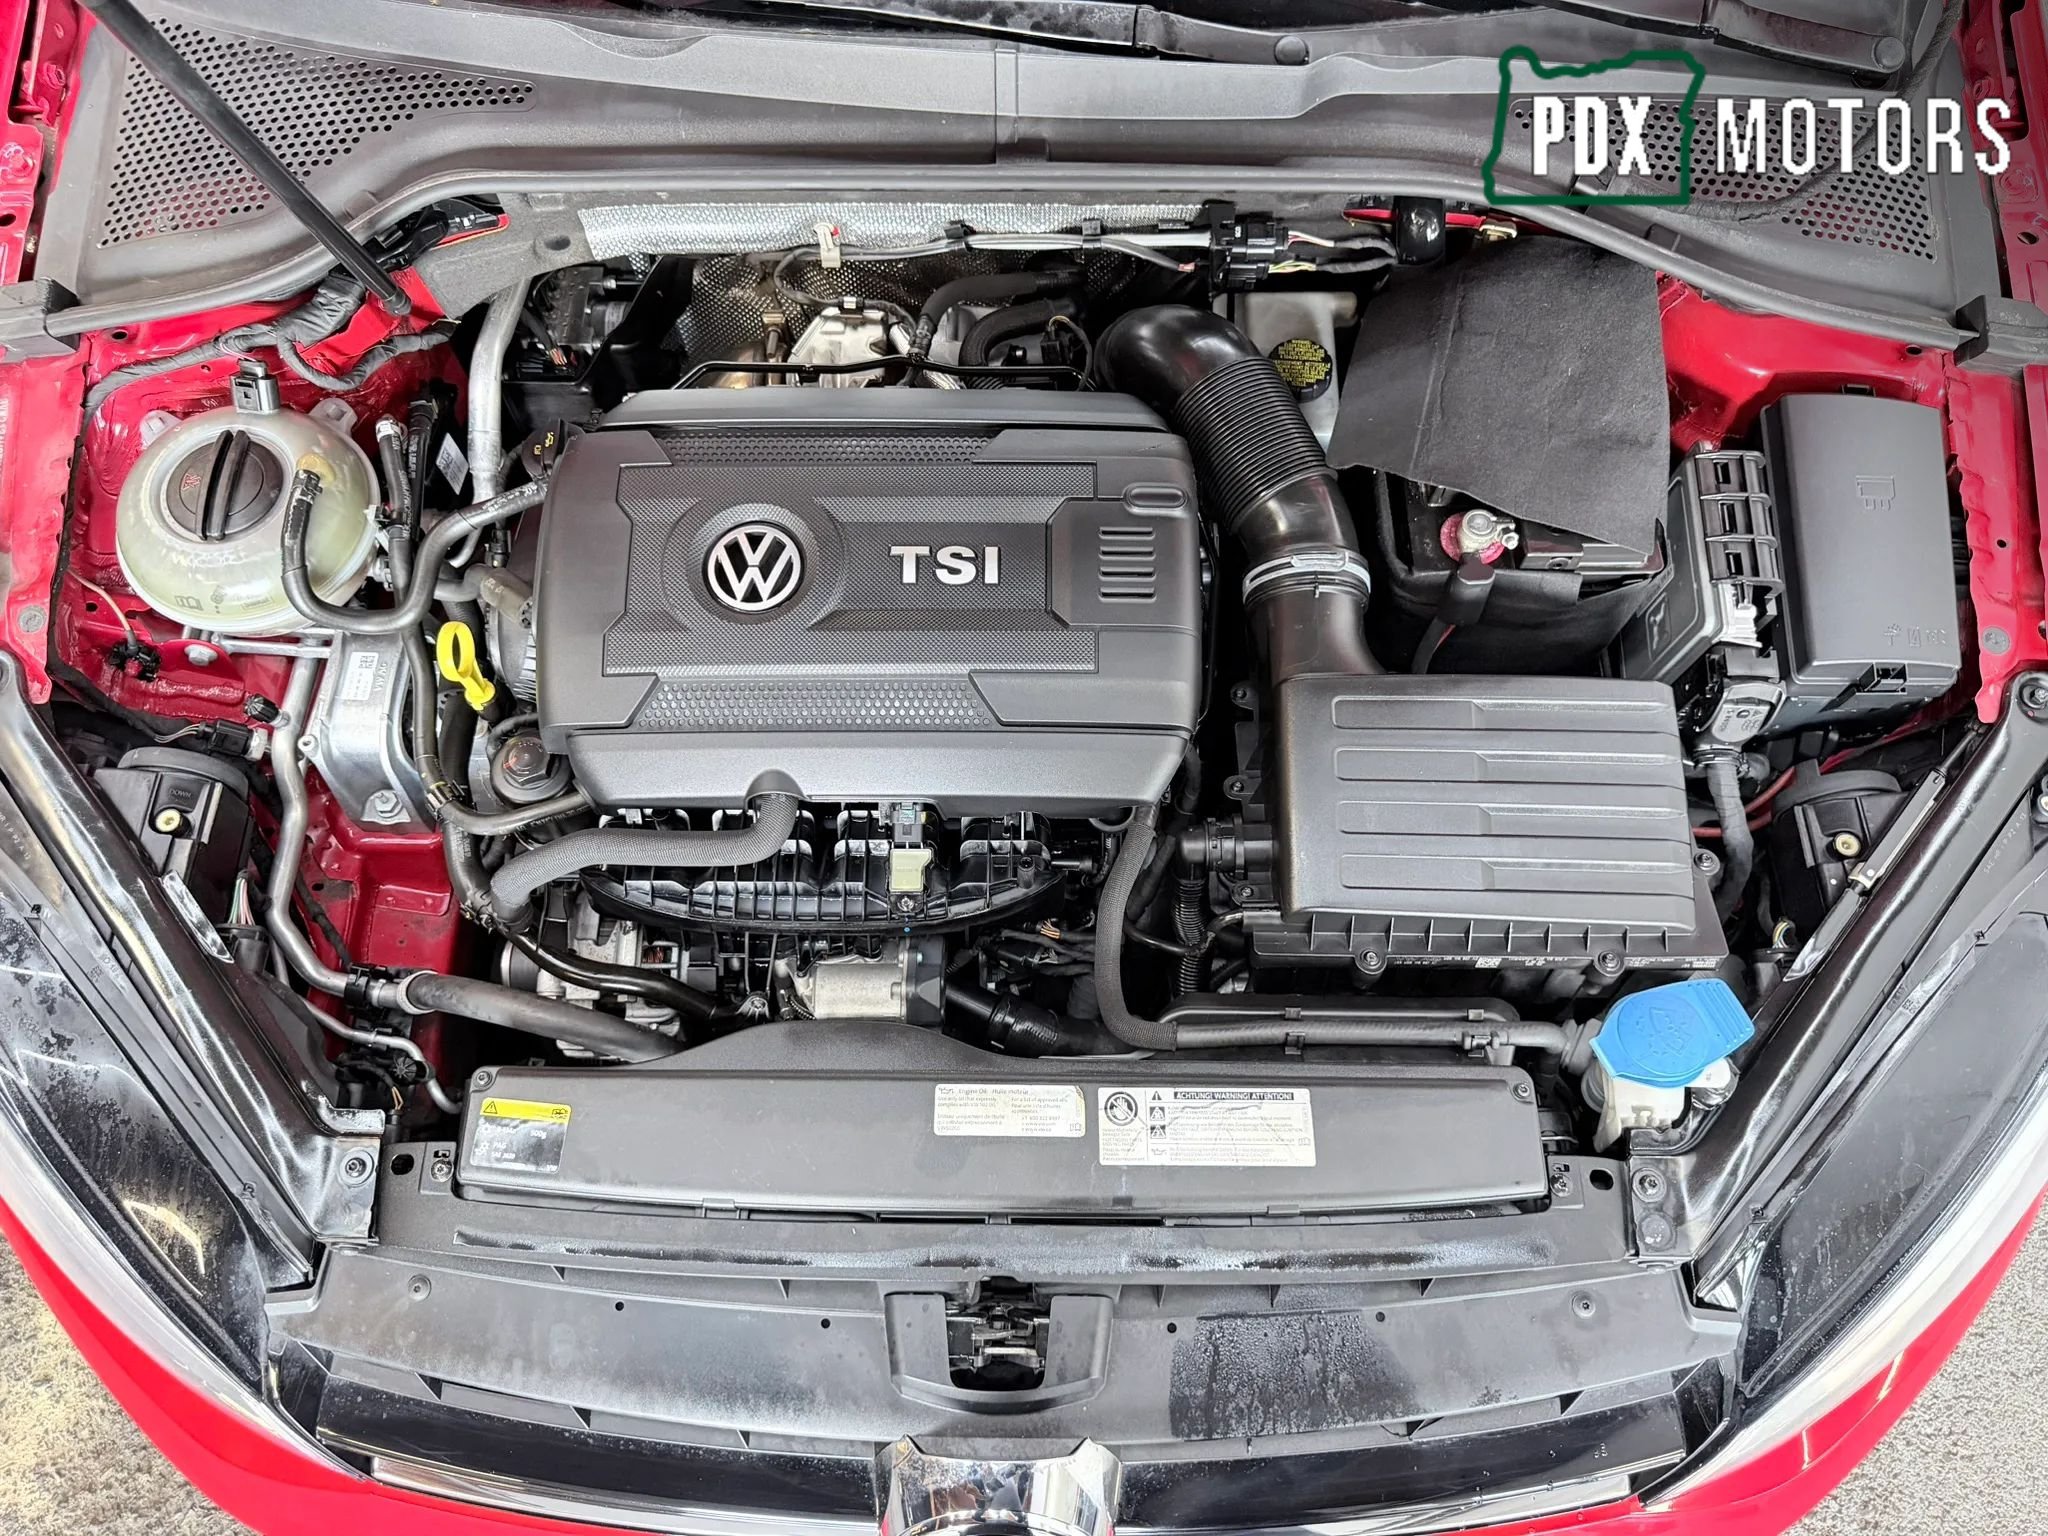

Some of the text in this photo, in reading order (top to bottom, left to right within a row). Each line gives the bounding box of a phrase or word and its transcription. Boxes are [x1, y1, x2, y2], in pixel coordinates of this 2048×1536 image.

[707, 524, 802, 611] VW
[890, 545, 1000, 585] TSI
[168, 787, 192, 798] DOWN
[958, 1088, 978, 1096] Engine
[1176, 1091, 1294, 1100] ACHTUNG! WARNING! ATTENTION!
